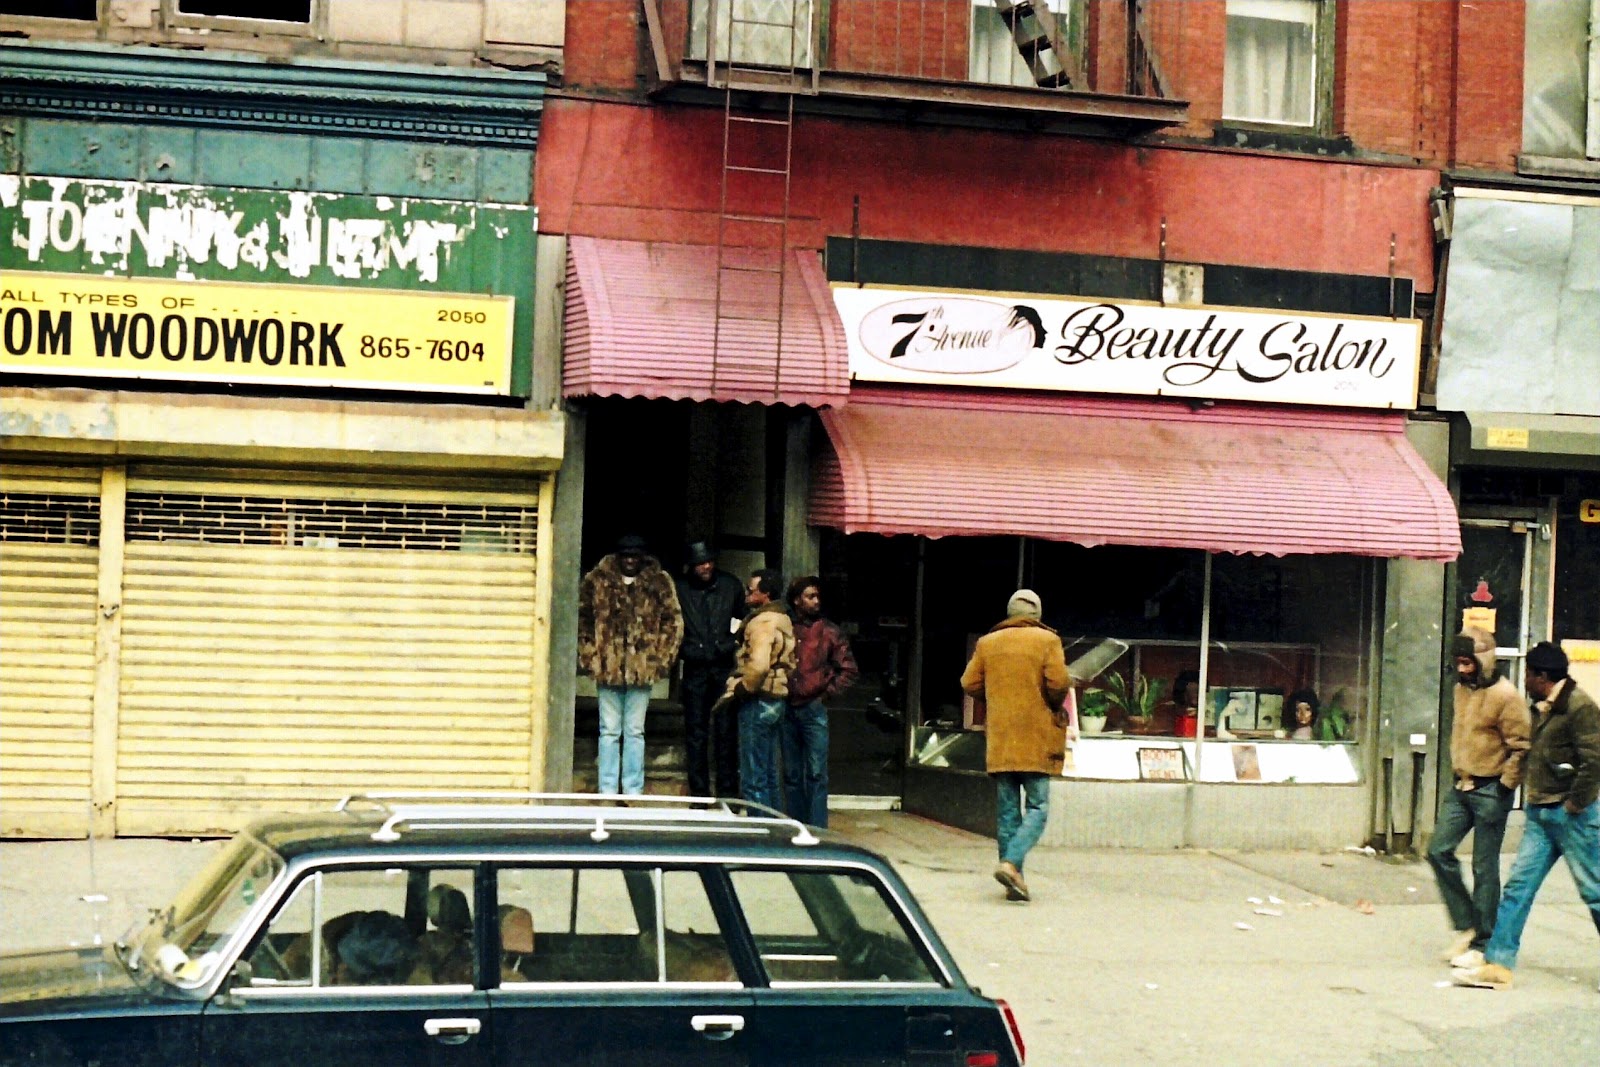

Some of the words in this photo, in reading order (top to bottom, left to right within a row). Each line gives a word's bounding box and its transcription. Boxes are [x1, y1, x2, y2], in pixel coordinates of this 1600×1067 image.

[1, 289, 44, 303] ALL
[59, 291, 138, 308] TYPES
[161, 297, 195, 309] OF
[437, 309, 487, 324] 2050
[0, 306, 72, 356] OM
[90, 312, 346, 368] WOODWORK
[360, 334, 485, 362] 865-7604
[1053, 303, 1245, 386] Beauty
[1236, 321, 1395, 383] Salon
